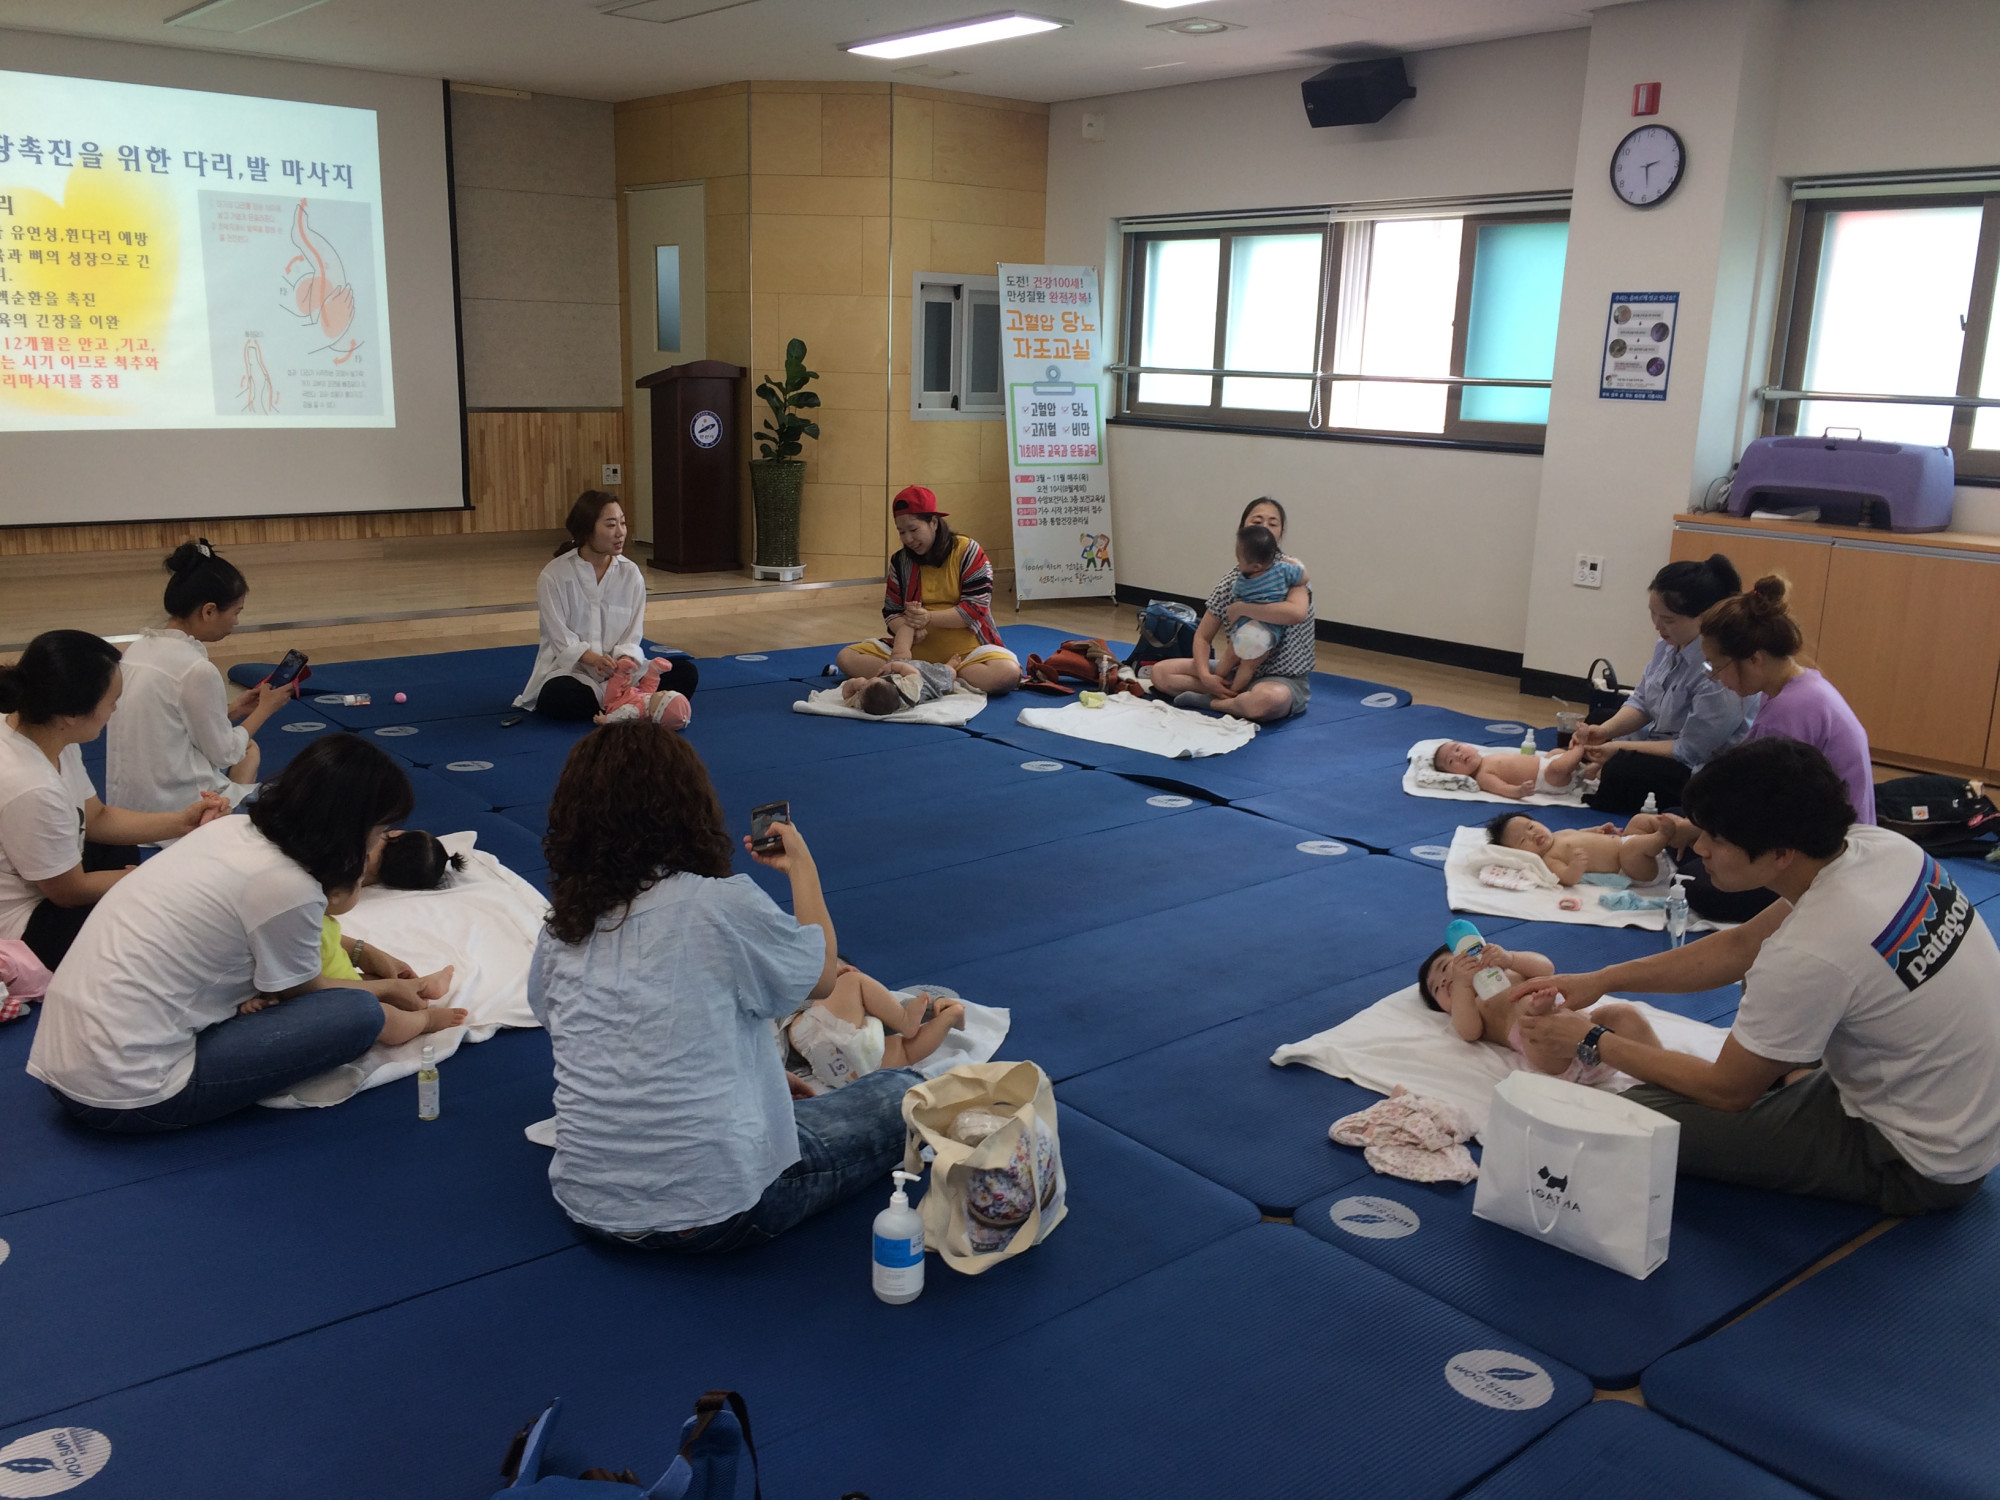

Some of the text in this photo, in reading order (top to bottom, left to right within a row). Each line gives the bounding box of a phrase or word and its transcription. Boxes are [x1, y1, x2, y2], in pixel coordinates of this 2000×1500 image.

[117, 145, 172, 175] 위한
[183, 150, 270, 182] 다리,발
[281, 158, 355, 189] 마사지
[118, 231, 148, 247] 예방
[29, 250, 60, 266] 뼈의
[68, 251, 130, 267] 성장으로
[136, 254, 151, 269] 긴
[1006, 276, 1084, 289] 도전! 건강100세!
[66, 291, 96, 308] 촉진
[1007, 290, 1092, 304] 만성질환 완전정복!
[36, 314, 82, 330] 긴장을
[89, 315, 120, 330] 이완
[1006, 309, 1096, 333] 고혈압 당뇨
[4, 336, 71, 352] 12개월은
[78, 337, 109, 352] 안고
[1013, 337, 1091, 360] 자조교실
[22, 355, 54, 370] 시기
[60, 356, 108, 370] 이므로
[114, 356, 160, 371] 척추와
[2, 374, 120, 390] 리마사지를 중점
[1031, 402, 1088, 417] 고혈압 당뇨
[1031, 422, 1090, 437] 고지혈 비만
[1019, 444, 1045, 458] 기초이론
[1070, 444, 1097, 457] 운동교육
[1036, 484, 1048, 493] 오전
[1453, 1364, 1486, 1383] WOO
[52, 1432, 74, 1457] SUNG
[63, 1456, 84, 1480] WOO
